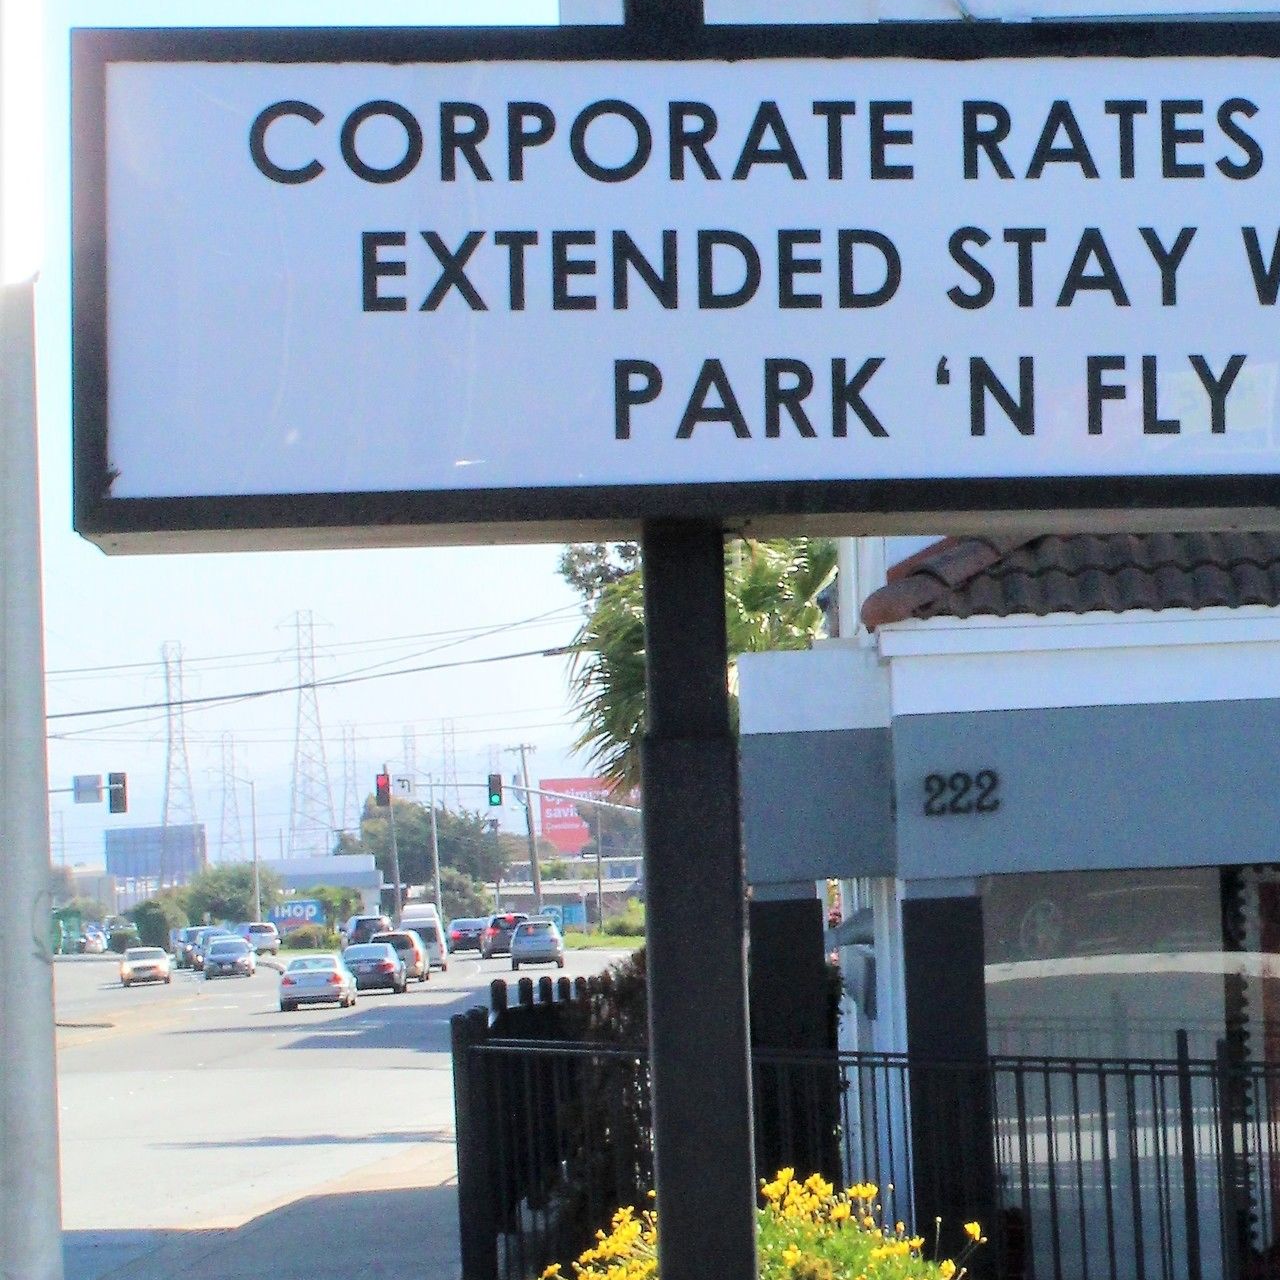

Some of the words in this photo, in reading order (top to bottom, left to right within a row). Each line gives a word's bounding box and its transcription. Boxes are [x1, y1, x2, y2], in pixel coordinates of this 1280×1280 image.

[250, 100, 913, 184] CORPORATE
[963, 98, 1263, 180] RATES
[362, 229, 901, 311] EXTENDED
[947, 227, 1197, 309] STAY
[615, 358, 889, 439] PARK
[1087, 355, 1246, 434] FLY
[924, 770, 1003, 816] 222
